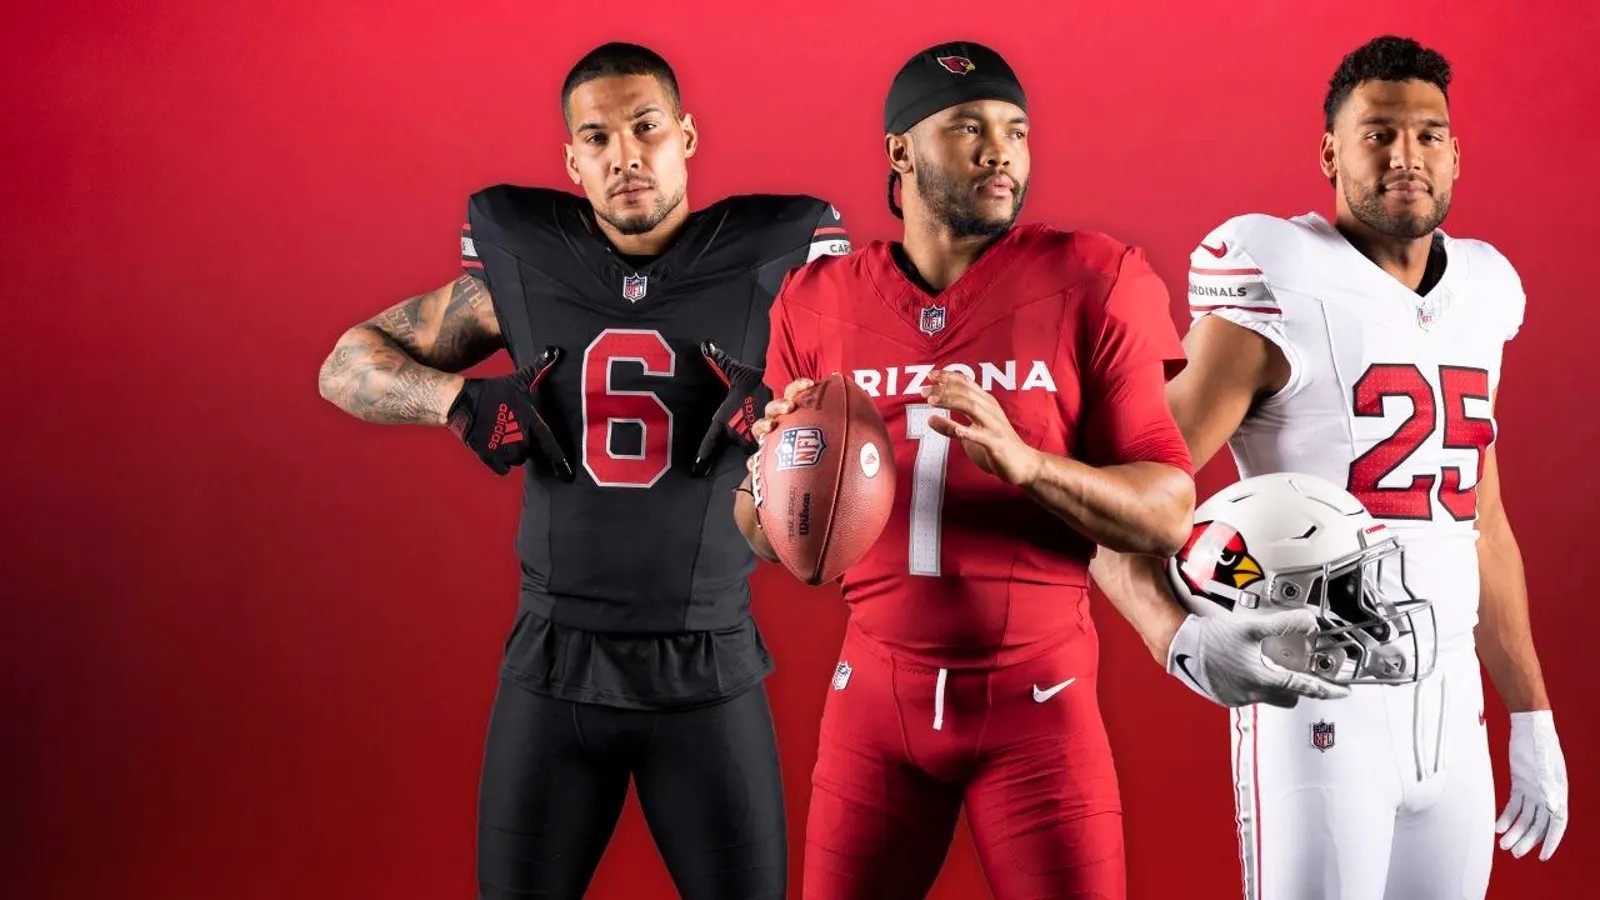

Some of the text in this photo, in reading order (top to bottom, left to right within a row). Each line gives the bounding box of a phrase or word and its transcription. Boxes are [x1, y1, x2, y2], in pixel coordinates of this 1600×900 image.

[1190, 285, 1247, 297] RDINALS
[853, 360, 1057, 397] RIZNA
[489, 403, 508, 449] adidas
[581, 329, 675, 488] 6
[795, 430, 820, 462] NFL
[1347, 363, 1495, 521] 25
[906, 403, 950, 576] 1
